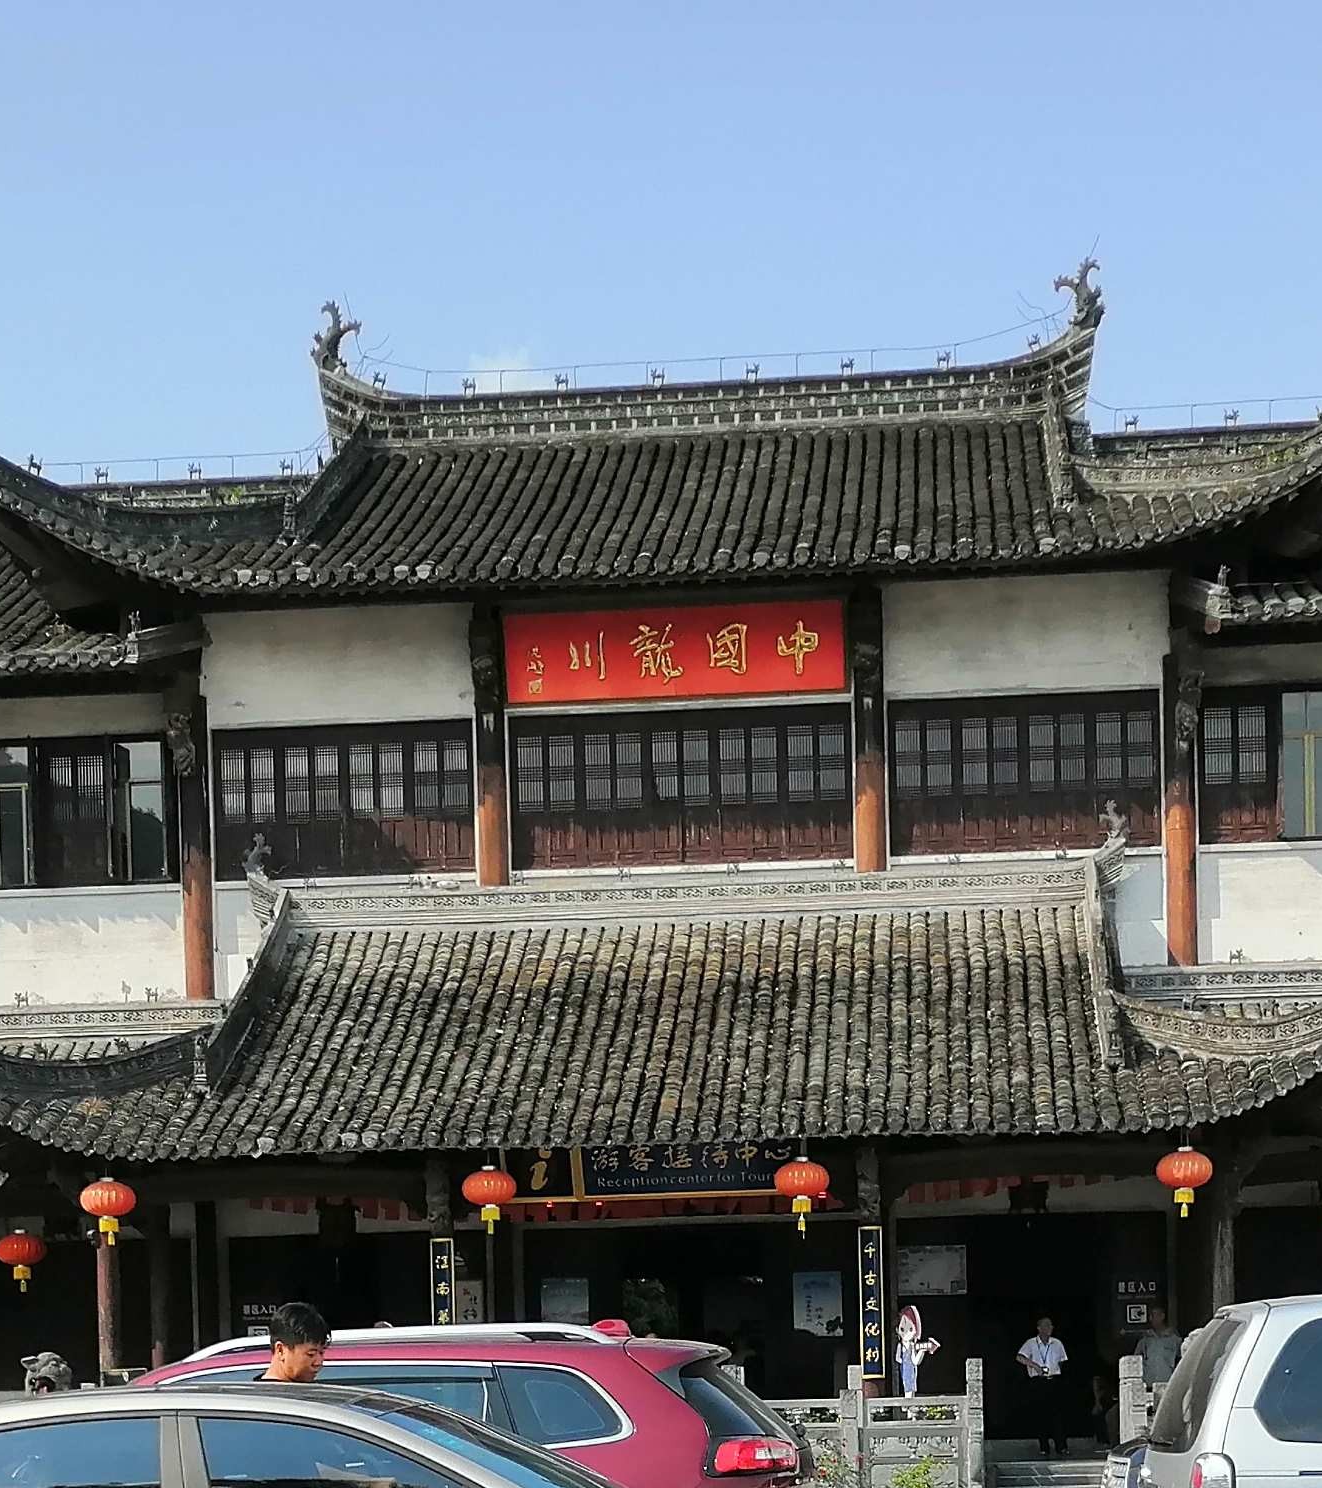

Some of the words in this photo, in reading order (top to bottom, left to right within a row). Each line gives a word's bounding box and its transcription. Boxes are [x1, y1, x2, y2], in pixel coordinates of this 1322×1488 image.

[597, 1174, 667, 1188] Reception
[717, 1172, 735, 1183] for
[740, 1171, 774, 1183] Tour
[434, 1254, 450, 1325] 江南第
